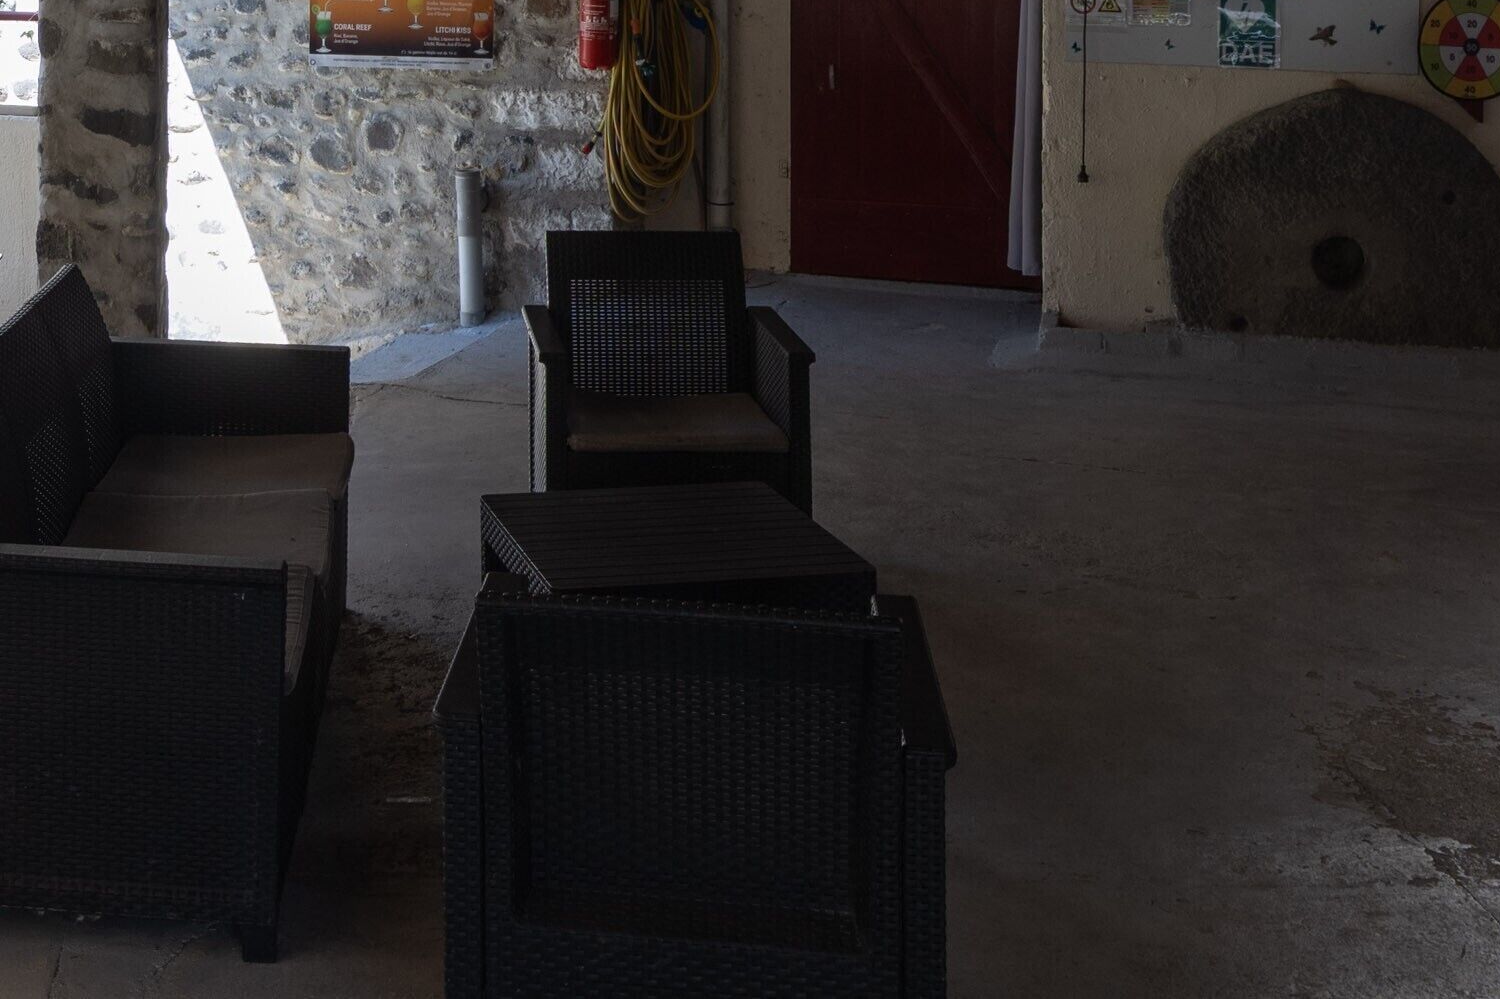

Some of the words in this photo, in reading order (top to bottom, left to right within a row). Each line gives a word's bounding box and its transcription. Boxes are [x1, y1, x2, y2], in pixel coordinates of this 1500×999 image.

[1467, 0, 1477, 8] 40
[333, 23, 355, 31] CORAL
[1430, 19, 1440, 28] 20
[1467, 20, 1477, 28] 20
[435, 26, 455, 34] LITCHI
[456, 26, 472, 34] KISS
[1486, 55, 1495, 63] 10
[1430, 63, 1439, 71] 10
